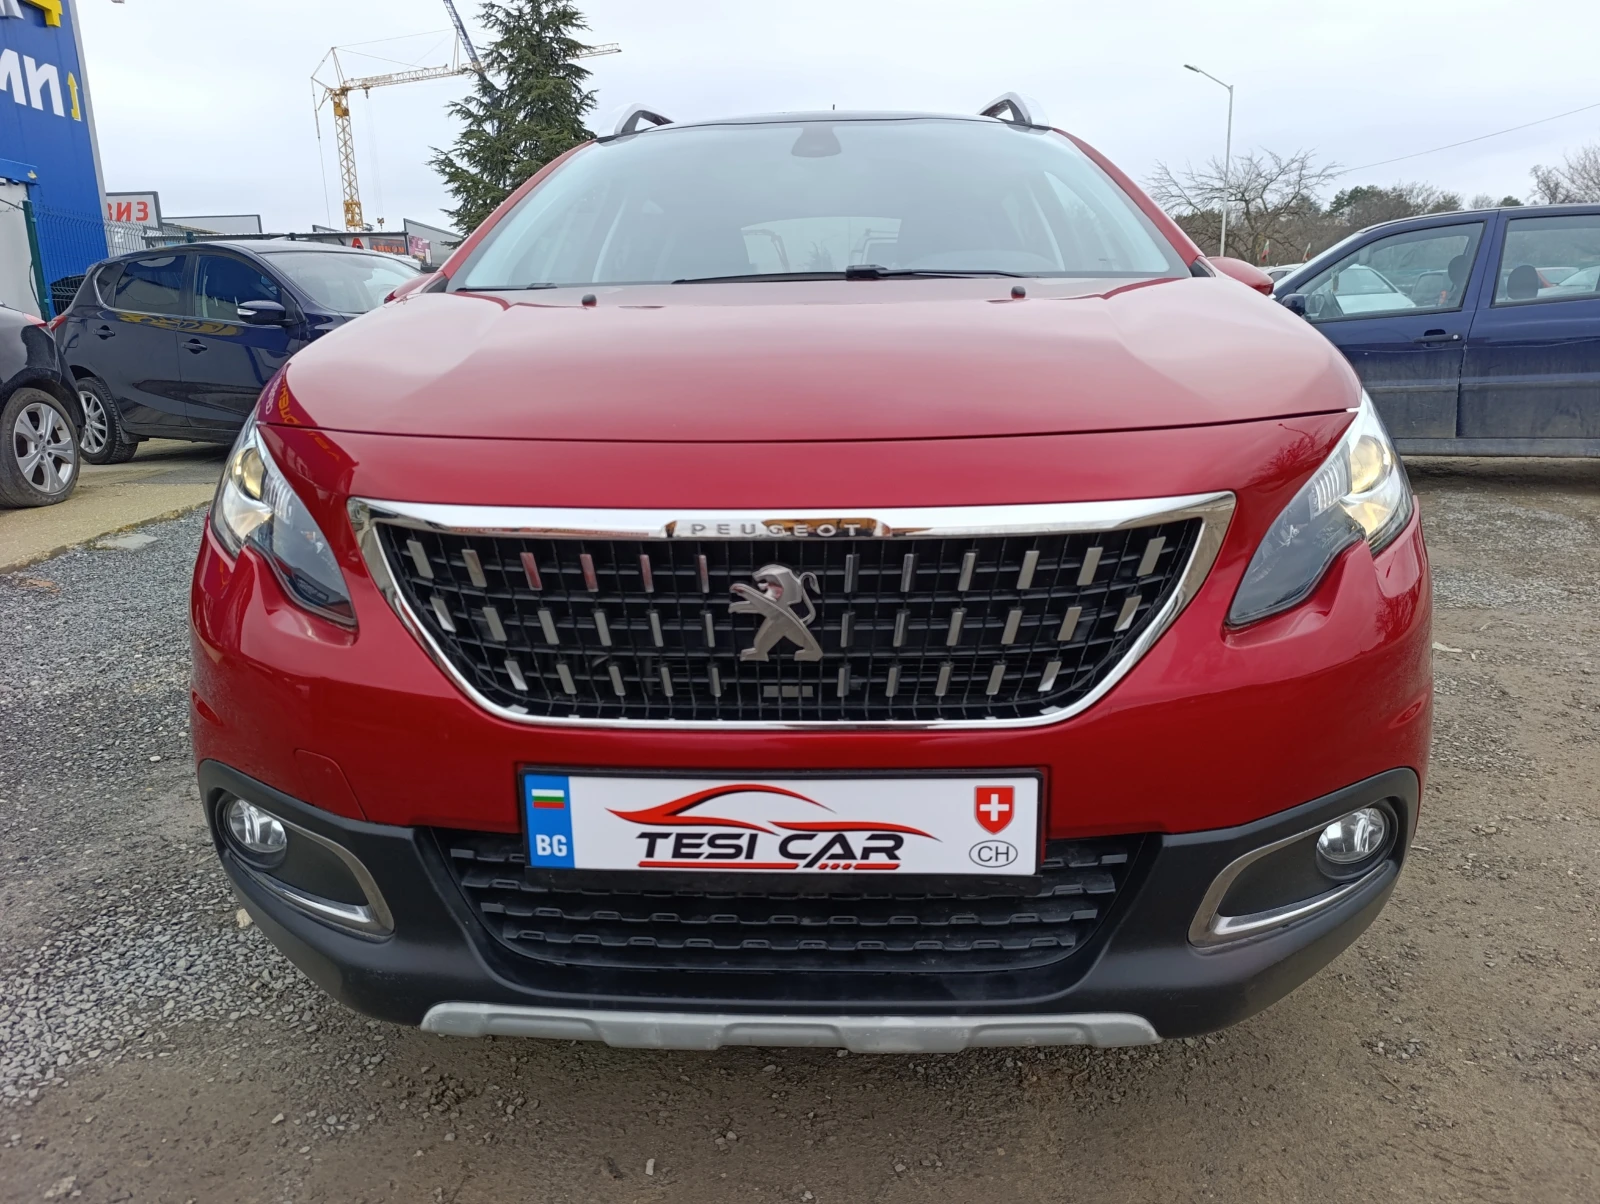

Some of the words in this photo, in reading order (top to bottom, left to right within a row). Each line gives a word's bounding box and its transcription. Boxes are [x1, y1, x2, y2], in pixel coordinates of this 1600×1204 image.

[691, 523, 861, 537] PEUGEOT
[535, 834, 567, 857] BG
[636, 832, 758, 860] TESI
[778, 833, 904, 868] CAR
[977, 846, 1010, 863] CH
